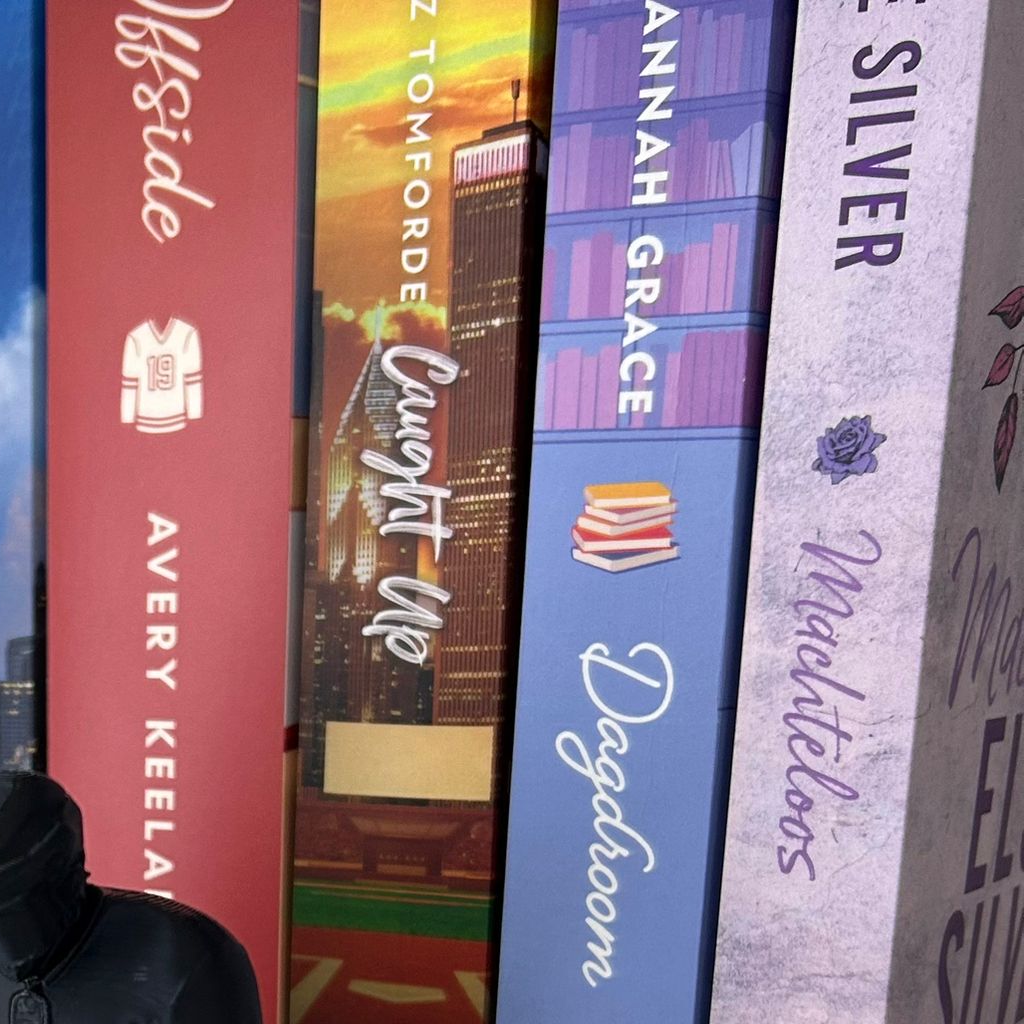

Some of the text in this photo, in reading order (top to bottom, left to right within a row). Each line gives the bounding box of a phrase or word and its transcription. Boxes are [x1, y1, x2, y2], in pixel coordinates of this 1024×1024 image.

[399, 39, 436, 303] TOMFORDE
[618, 0, 681, 415] ANNAH GRACE
[834, 38, 922, 271] SILVER
[146, 353, 175, 392] 19
[359, 344, 461, 667] Caught Up
[145, 511, 180, 690] AVERY
[776, 529, 883, 882] Machteloos
[555, 641, 674, 988] Dagdroom
